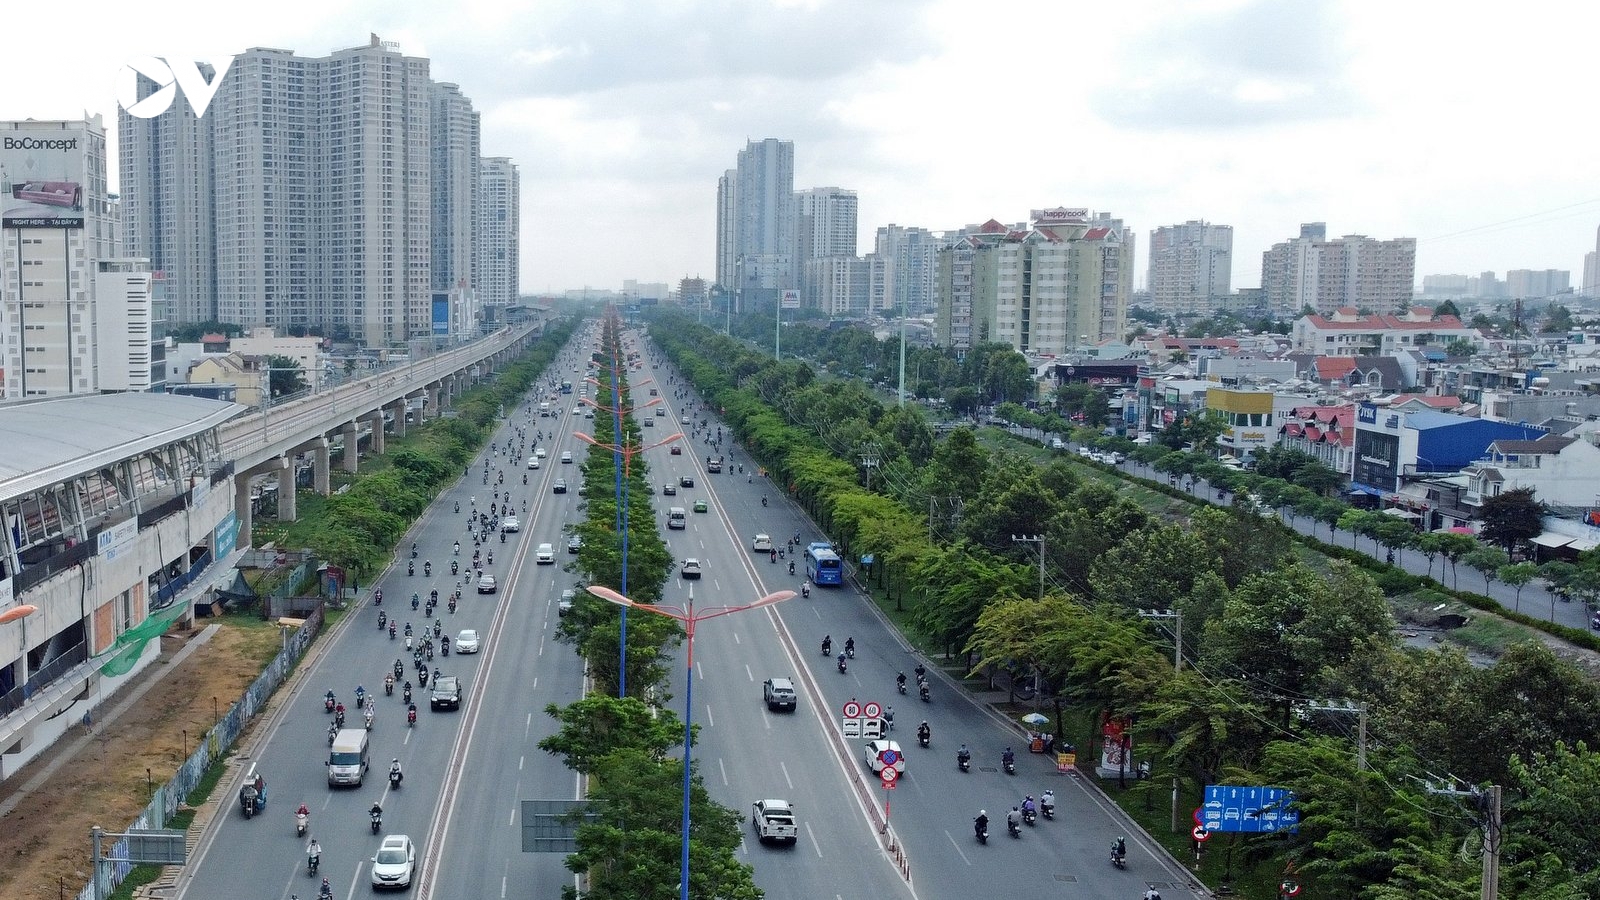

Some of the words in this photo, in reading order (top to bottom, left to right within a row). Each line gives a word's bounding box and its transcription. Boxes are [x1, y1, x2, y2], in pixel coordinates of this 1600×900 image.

[4, 137, 77, 152] BoConcept
[848, 706, 856, 715] 80
[868, 706, 877, 715] 60
